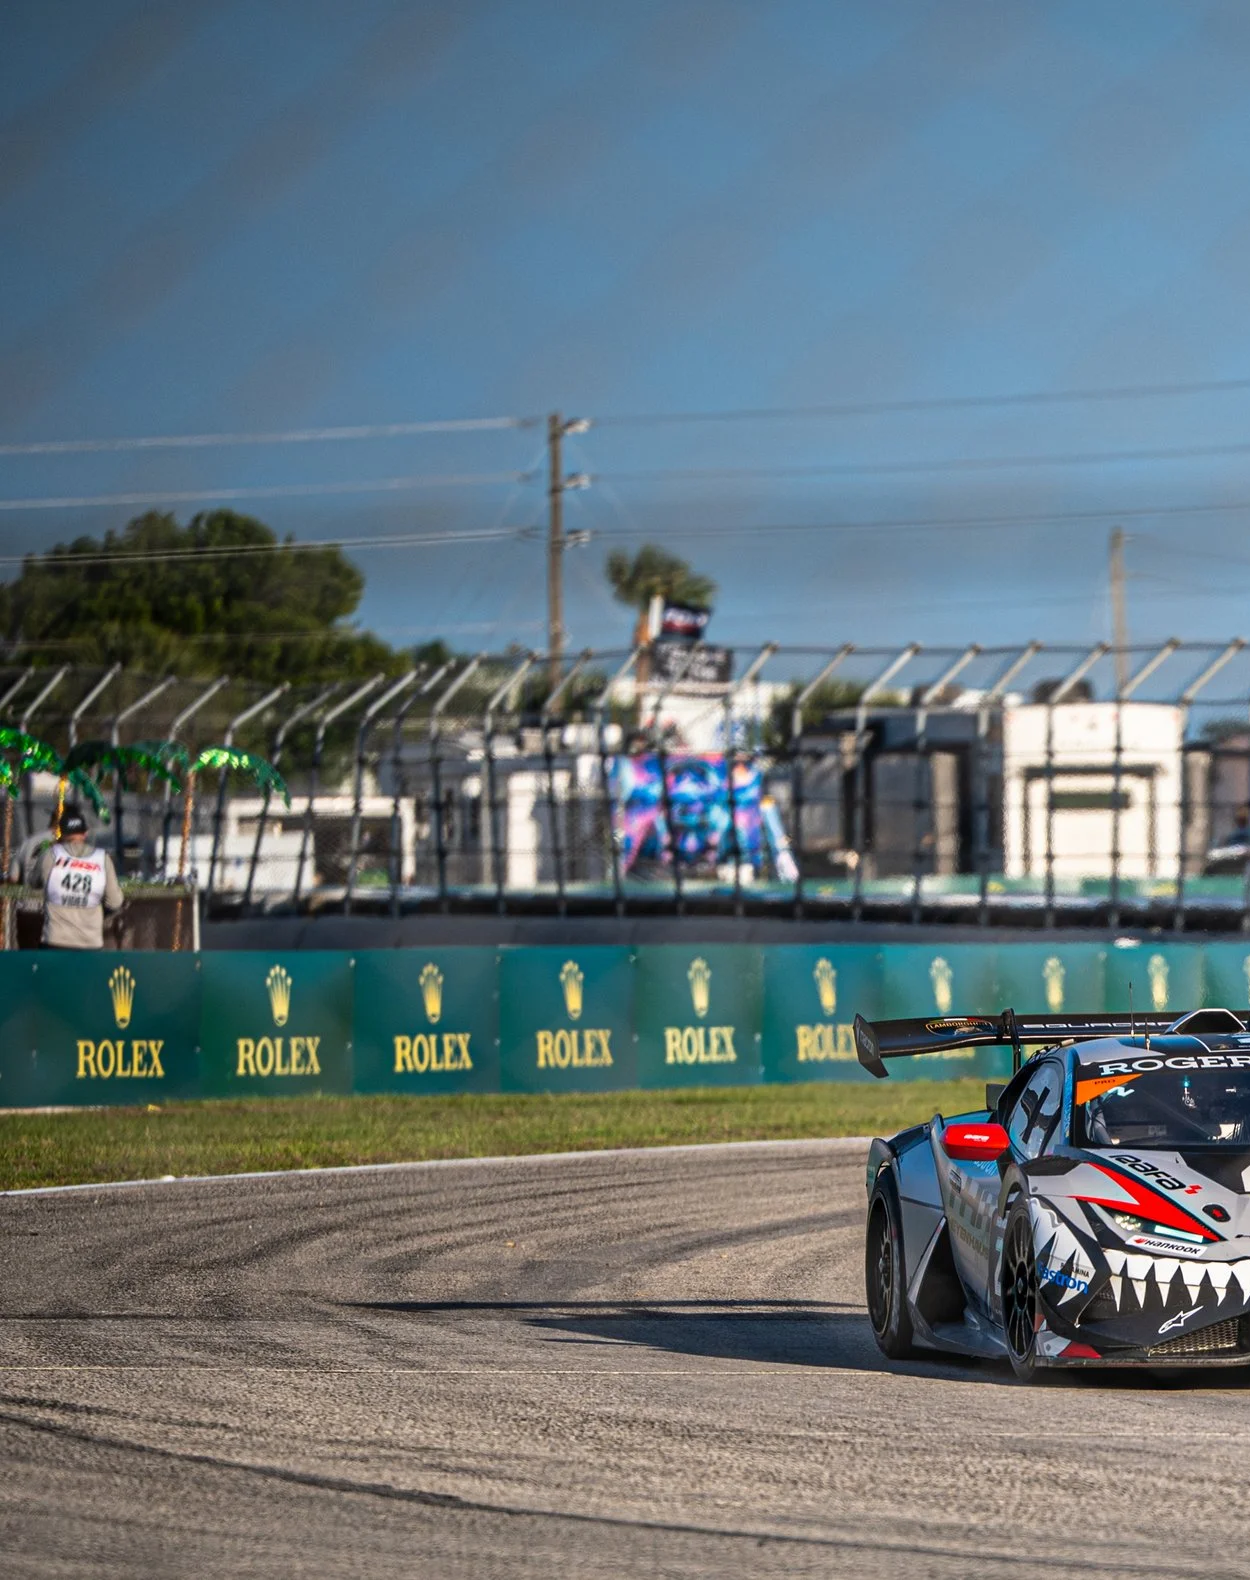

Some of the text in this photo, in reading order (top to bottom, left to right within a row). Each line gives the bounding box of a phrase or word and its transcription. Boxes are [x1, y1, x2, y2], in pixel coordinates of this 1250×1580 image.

[76, 1039, 165, 1079] ROLEX
[236, 1036, 321, 1077] ROLEX
[394, 1033, 473, 1073] ROLEX
[536, 1029, 614, 1068] ROLEX
[666, 1026, 736, 1064] ROLEX
